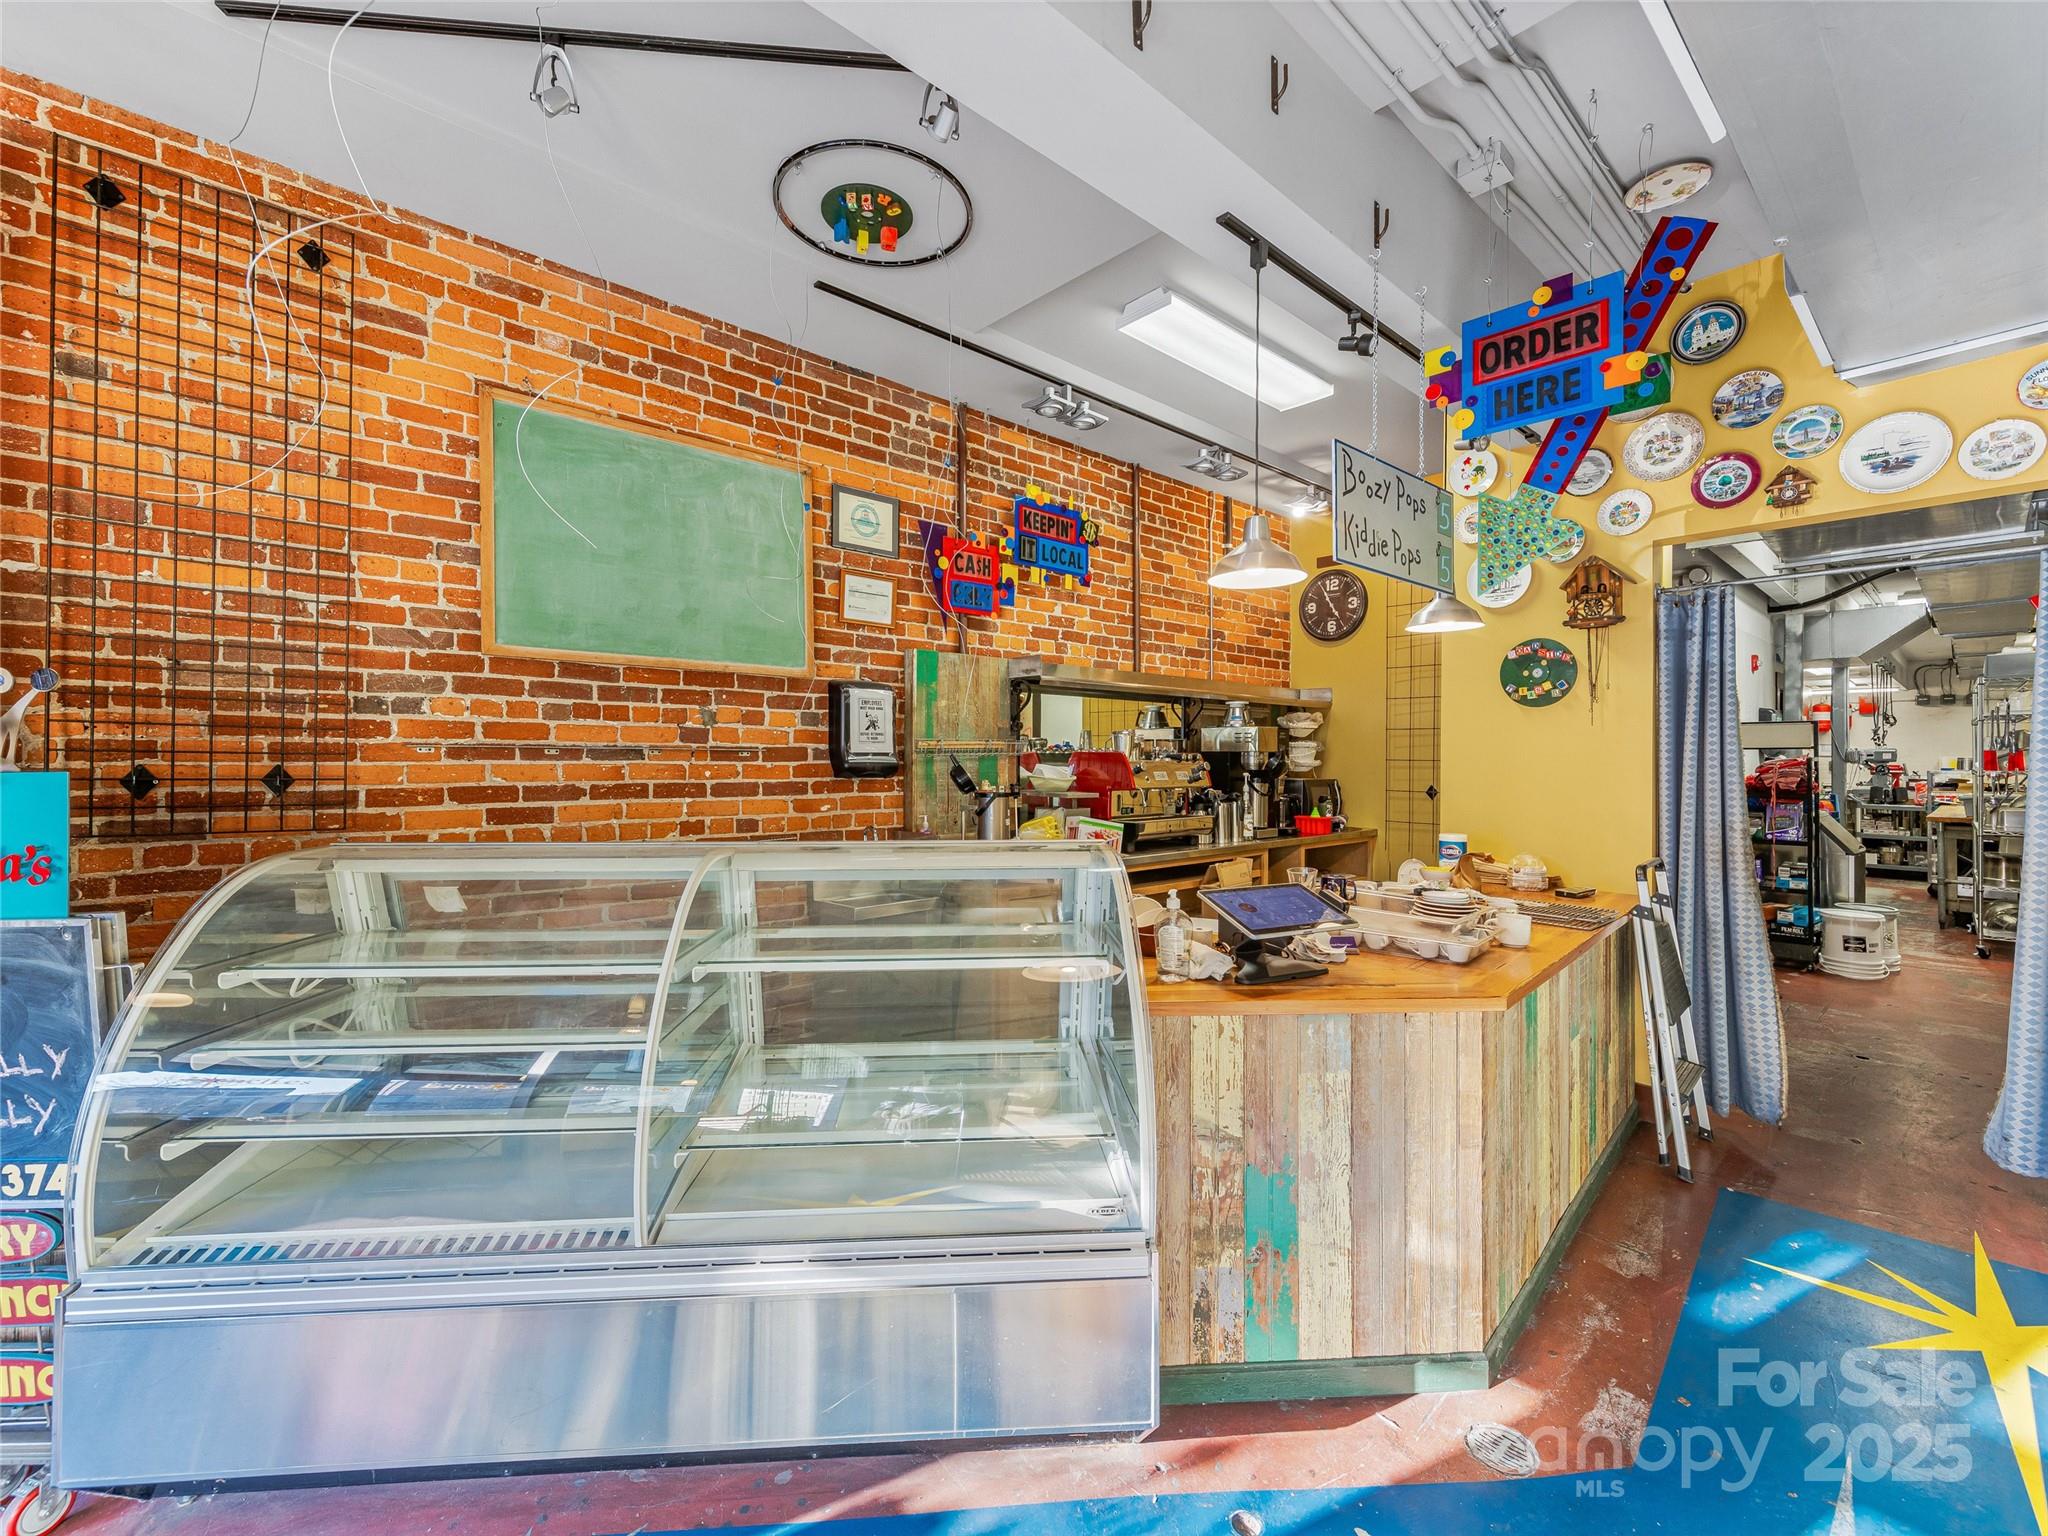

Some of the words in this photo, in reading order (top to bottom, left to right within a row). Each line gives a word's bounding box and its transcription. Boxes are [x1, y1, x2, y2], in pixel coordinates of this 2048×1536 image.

[1480, 312, 1599, 375] ORDER
[1494, 366, 1580, 422] HERE
[1342, 447, 1391, 504] Boozy
[1396, 475, 1426, 521] Pops
[1023, 509, 1074, 538] KEEPIN'
[1022, 537, 1035, 559] IT
[1041, 544, 1084, 569] LOCAL
[1343, 510, 1389, 558] Kiddie
[1391, 528, 1422, 576] Pops
[1325, 578, 1339, 591] 12
[1308, 602, 1317, 614] 9
[1347, 597, 1358, 609] 3
[1327, 620, 1336, 632] 6
[1, 1164, 68, 1197] 374
